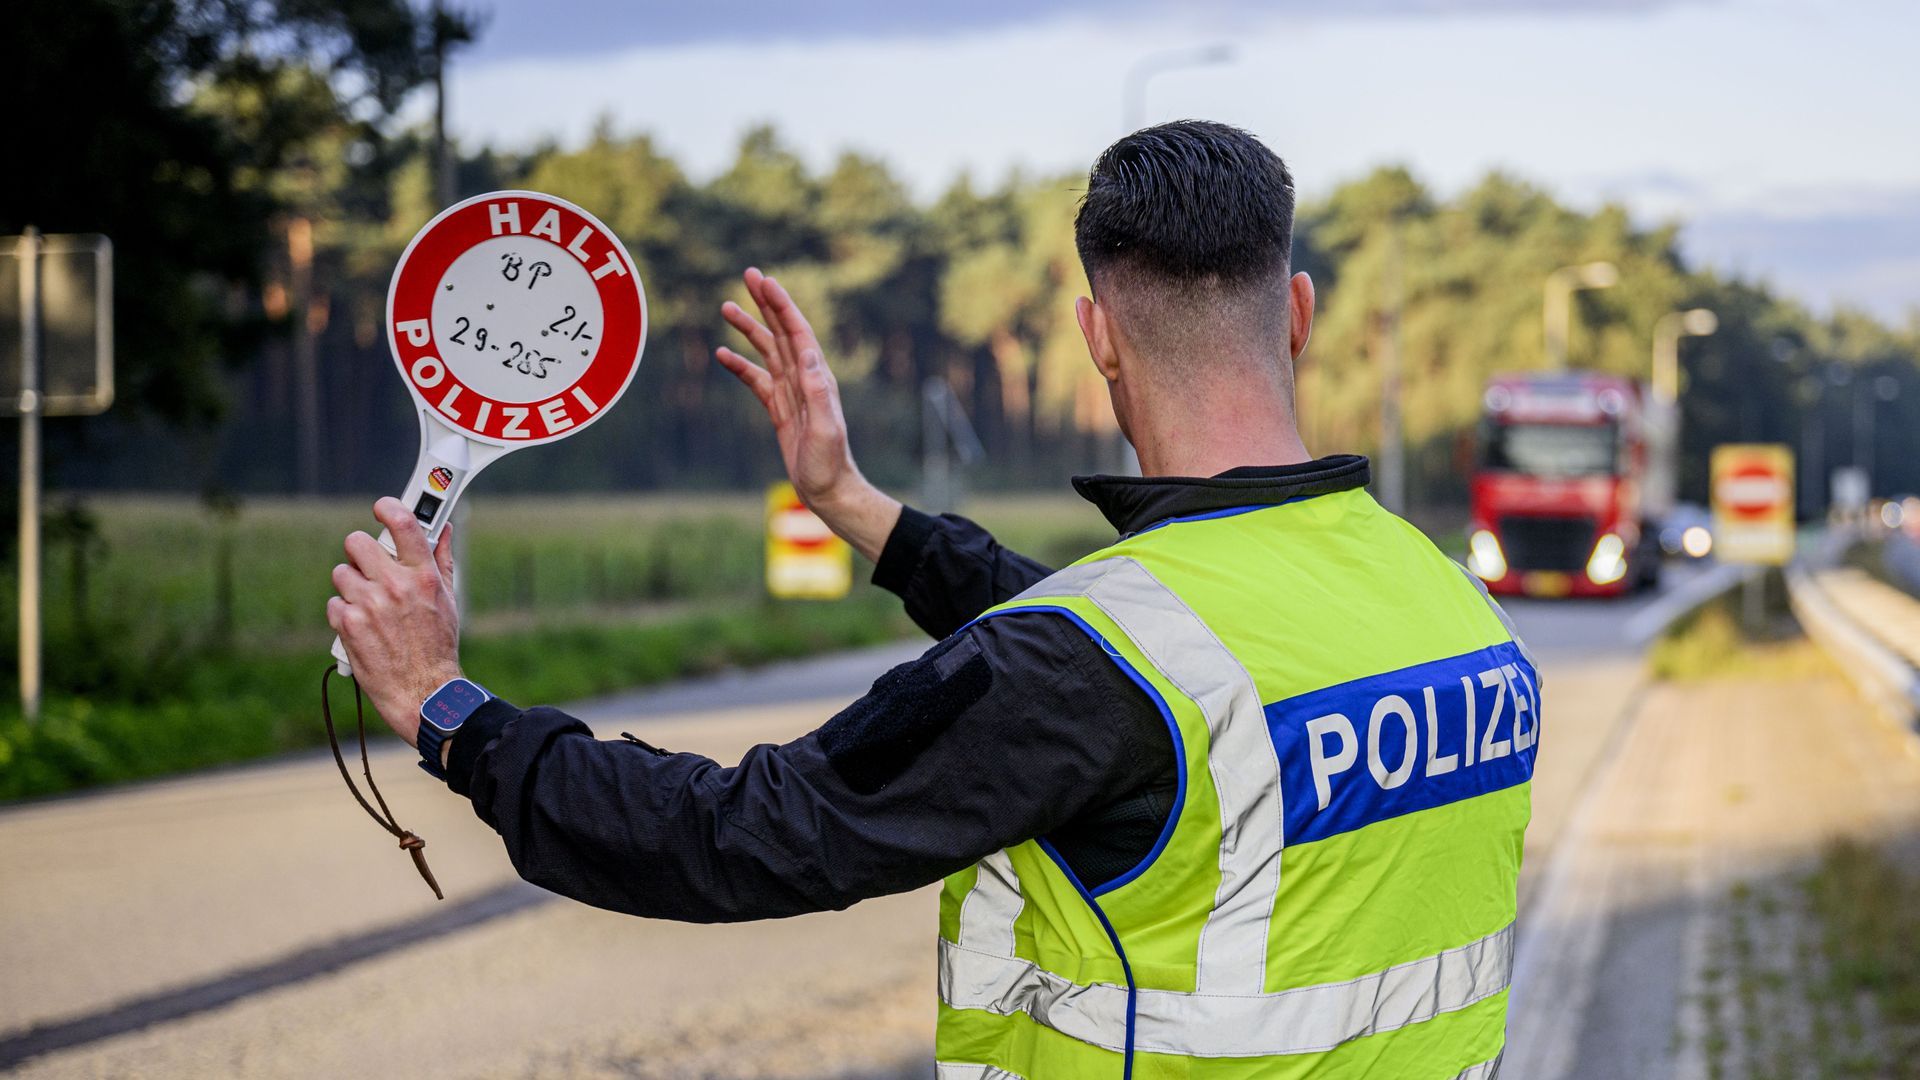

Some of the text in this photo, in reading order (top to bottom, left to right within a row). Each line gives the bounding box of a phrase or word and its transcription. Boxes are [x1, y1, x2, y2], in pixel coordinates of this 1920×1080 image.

[488, 202, 628, 281] HALT
[501, 252, 552, 290] BP
[396, 318, 600, 439] POLIZEI
